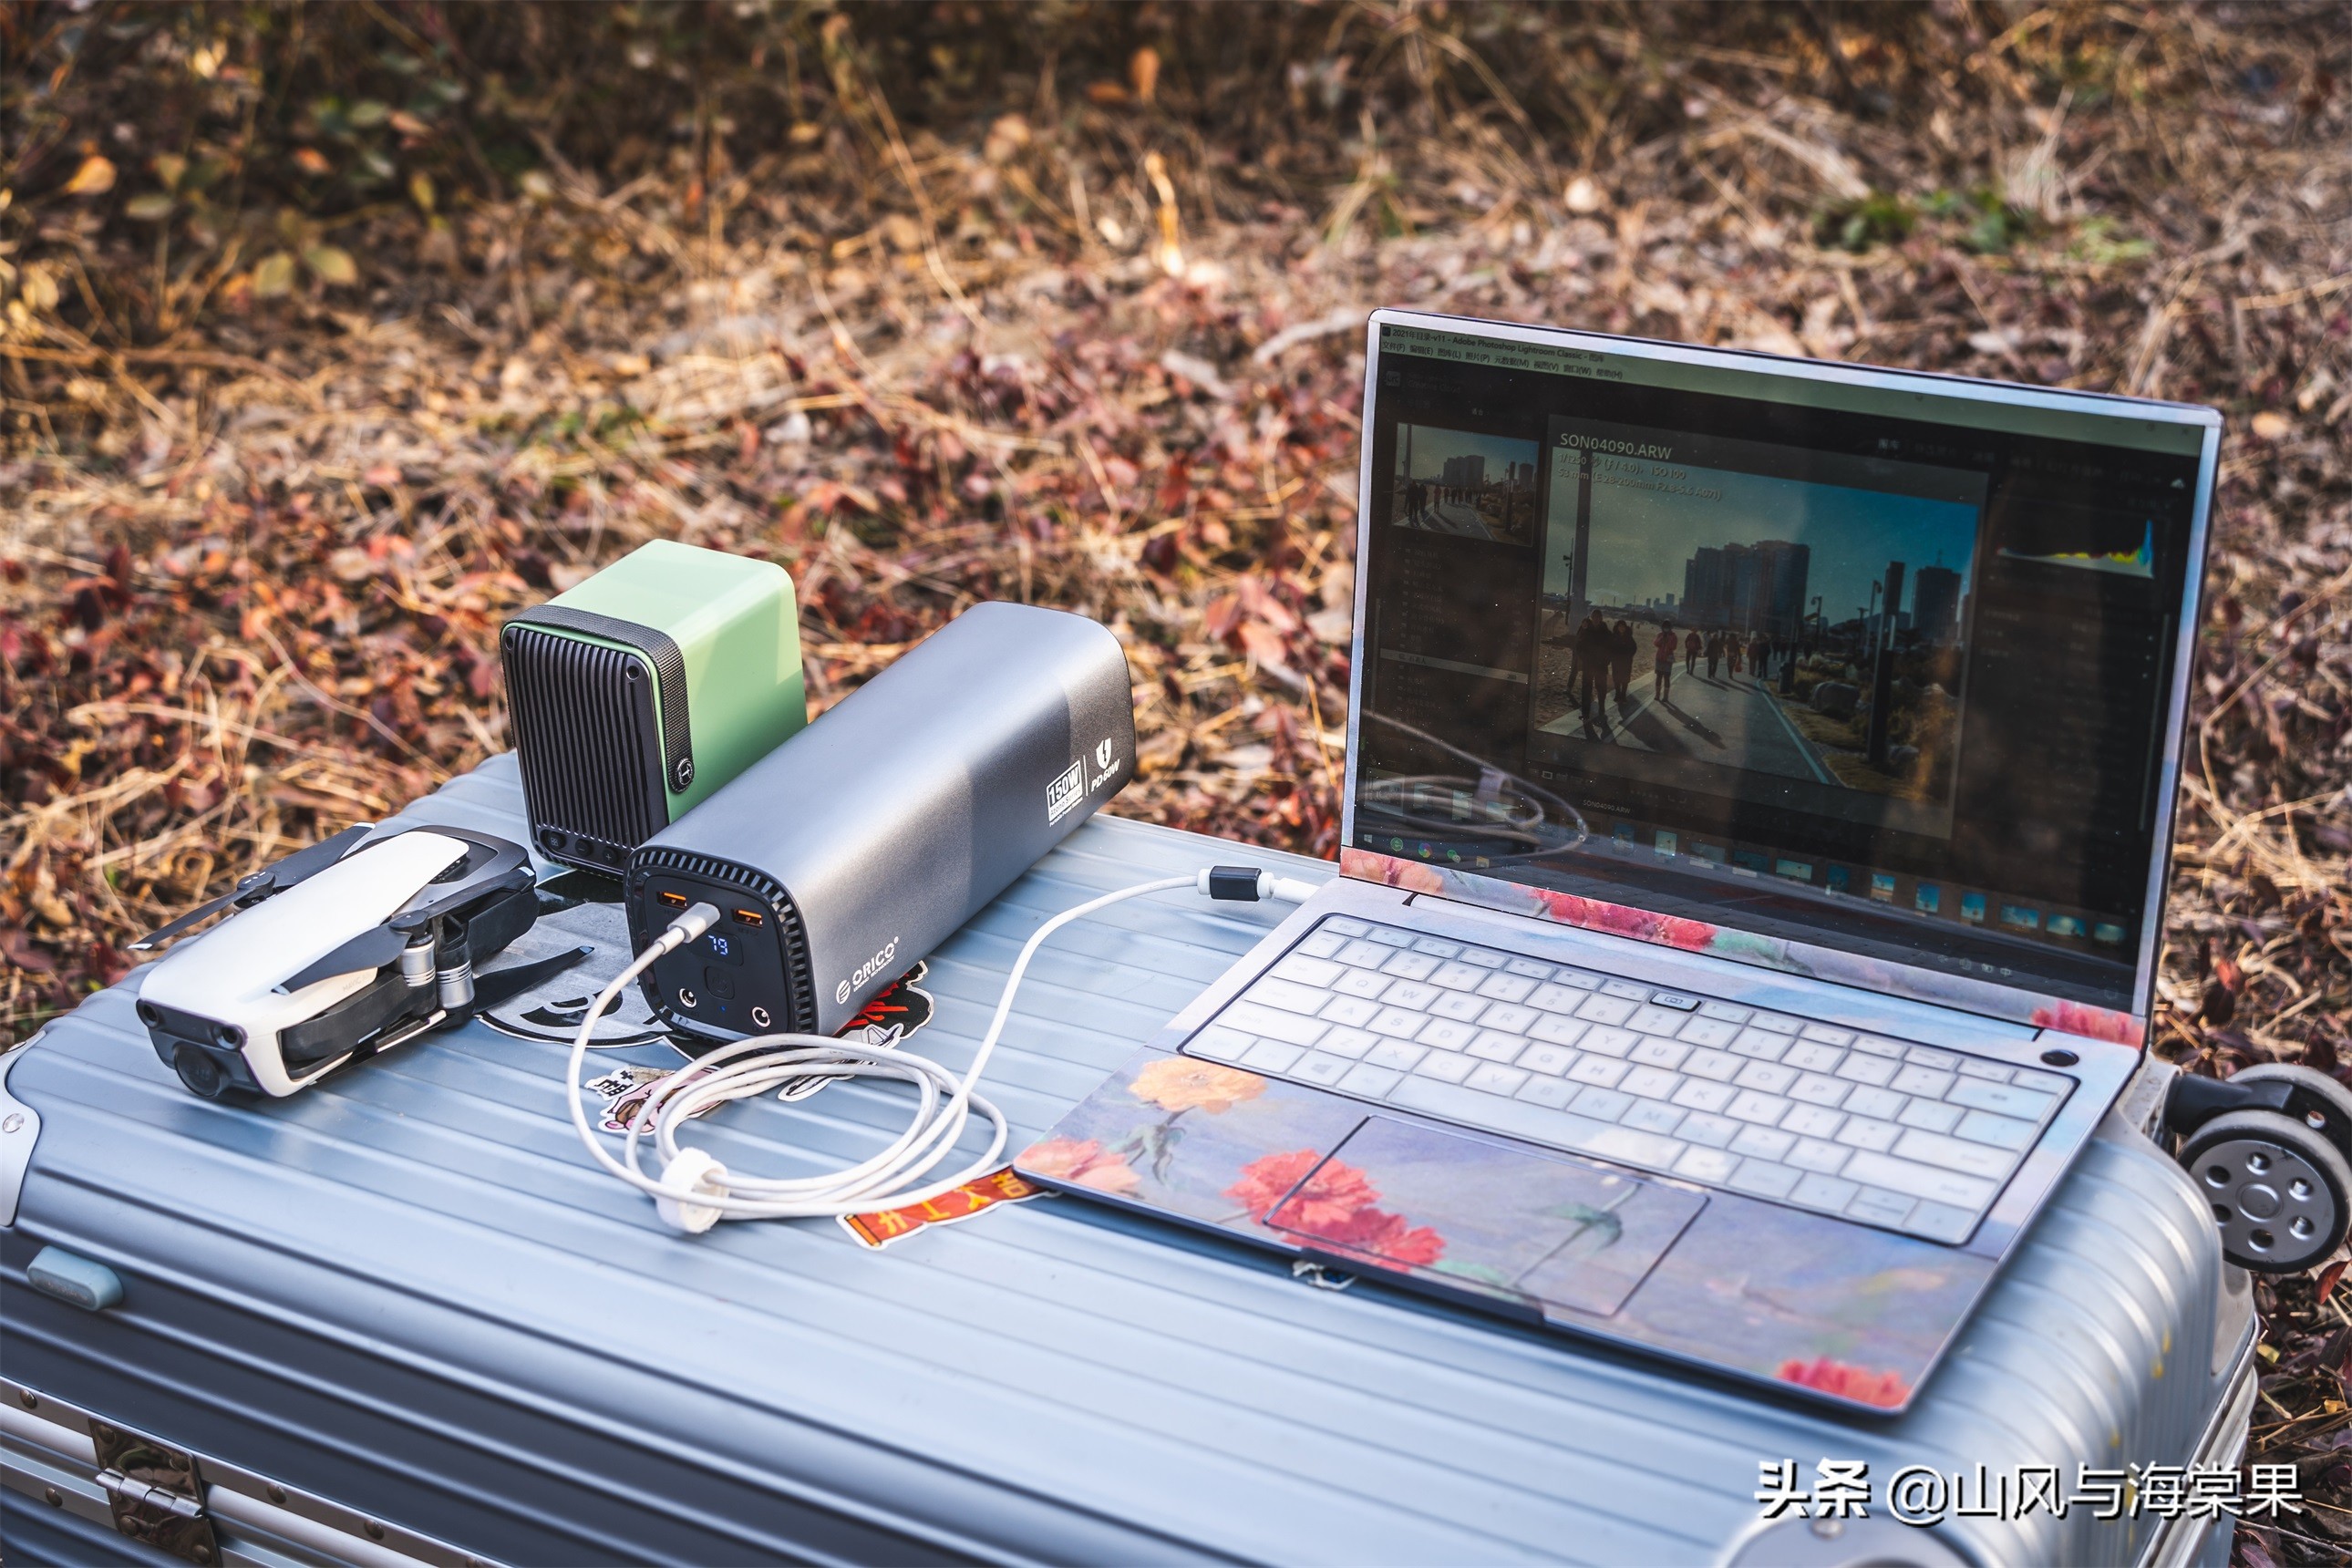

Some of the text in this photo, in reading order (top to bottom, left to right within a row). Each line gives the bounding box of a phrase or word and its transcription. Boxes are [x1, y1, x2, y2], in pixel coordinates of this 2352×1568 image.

[1382, 341, 1406, 353] 文件(F)
[1453, 337, 1476, 347] Adobe
[1478, 340, 1516, 352] Photoshop
[1518, 345, 1555, 358] Lightroom
[1557, 349, 1582, 360] Classic
[1560, 433, 1671, 459] SON04090.ARW
[1557, 468, 1569, 478] 53
[1571, 471, 1589, 481] mm
[1558, 454, 1587, 465] 1/1250
[1651, 465, 1667, 478] ISO
[1670, 468, 1687, 480] 100
[1048, 766, 1080, 805] 150W
[1582, 799, 1631, 814] SON04090.ARW
[707, 934, 729, 956] 79
[852, 942, 895, 986] ORICO
[1402, 990, 1420, 999] W
[1450, 1001, 1464, 1009] E
[1499, 1013, 1514, 1021] R
[1605, 1036, 1616, 1044] Y
[1652, 1048, 1667, 1056] U
[1757, 1072, 1772, 1080] O
[1339, 1038, 1354, 1047] Z
[1387, 1050, 1402, 1059] X
[1438, 1061, 1453, 1071] C
[1491, 1074, 1503, 1083] V
[1540, 1086, 1554, 1096] B
[1591, 1099, 1607, 1109] N
[1643, 1111, 1661, 1121] M
[1439, 1029, 1453, 1038] D
[1539, 1055, 1553, 1063] G
[1590, 1066, 1605, 1075] H
[1644, 1079, 1656, 1087] J
[1694, 1090, 1709, 1100] K
[1750, 1103, 1761, 1113] L
